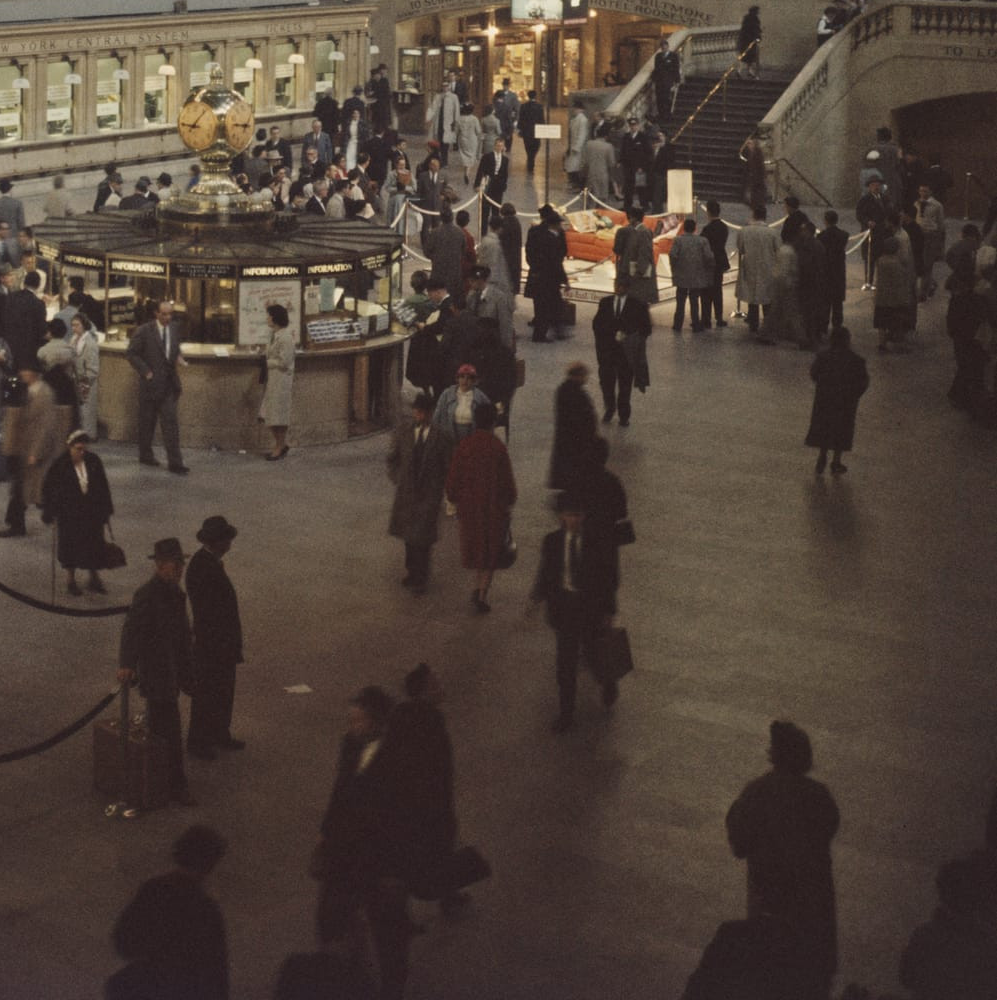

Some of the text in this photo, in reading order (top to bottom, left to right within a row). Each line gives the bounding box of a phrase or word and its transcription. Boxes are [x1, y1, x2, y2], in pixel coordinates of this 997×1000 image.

[19, 39, 57, 53] YORK
[66, 33, 128, 49] CENTRAL
[137, 30, 190, 44] SYSTEM
[111, 260, 165, 274] INFORMATION
[242, 266, 299, 277] INFORMATION
[307, 263, 353, 275] INFORMATION
